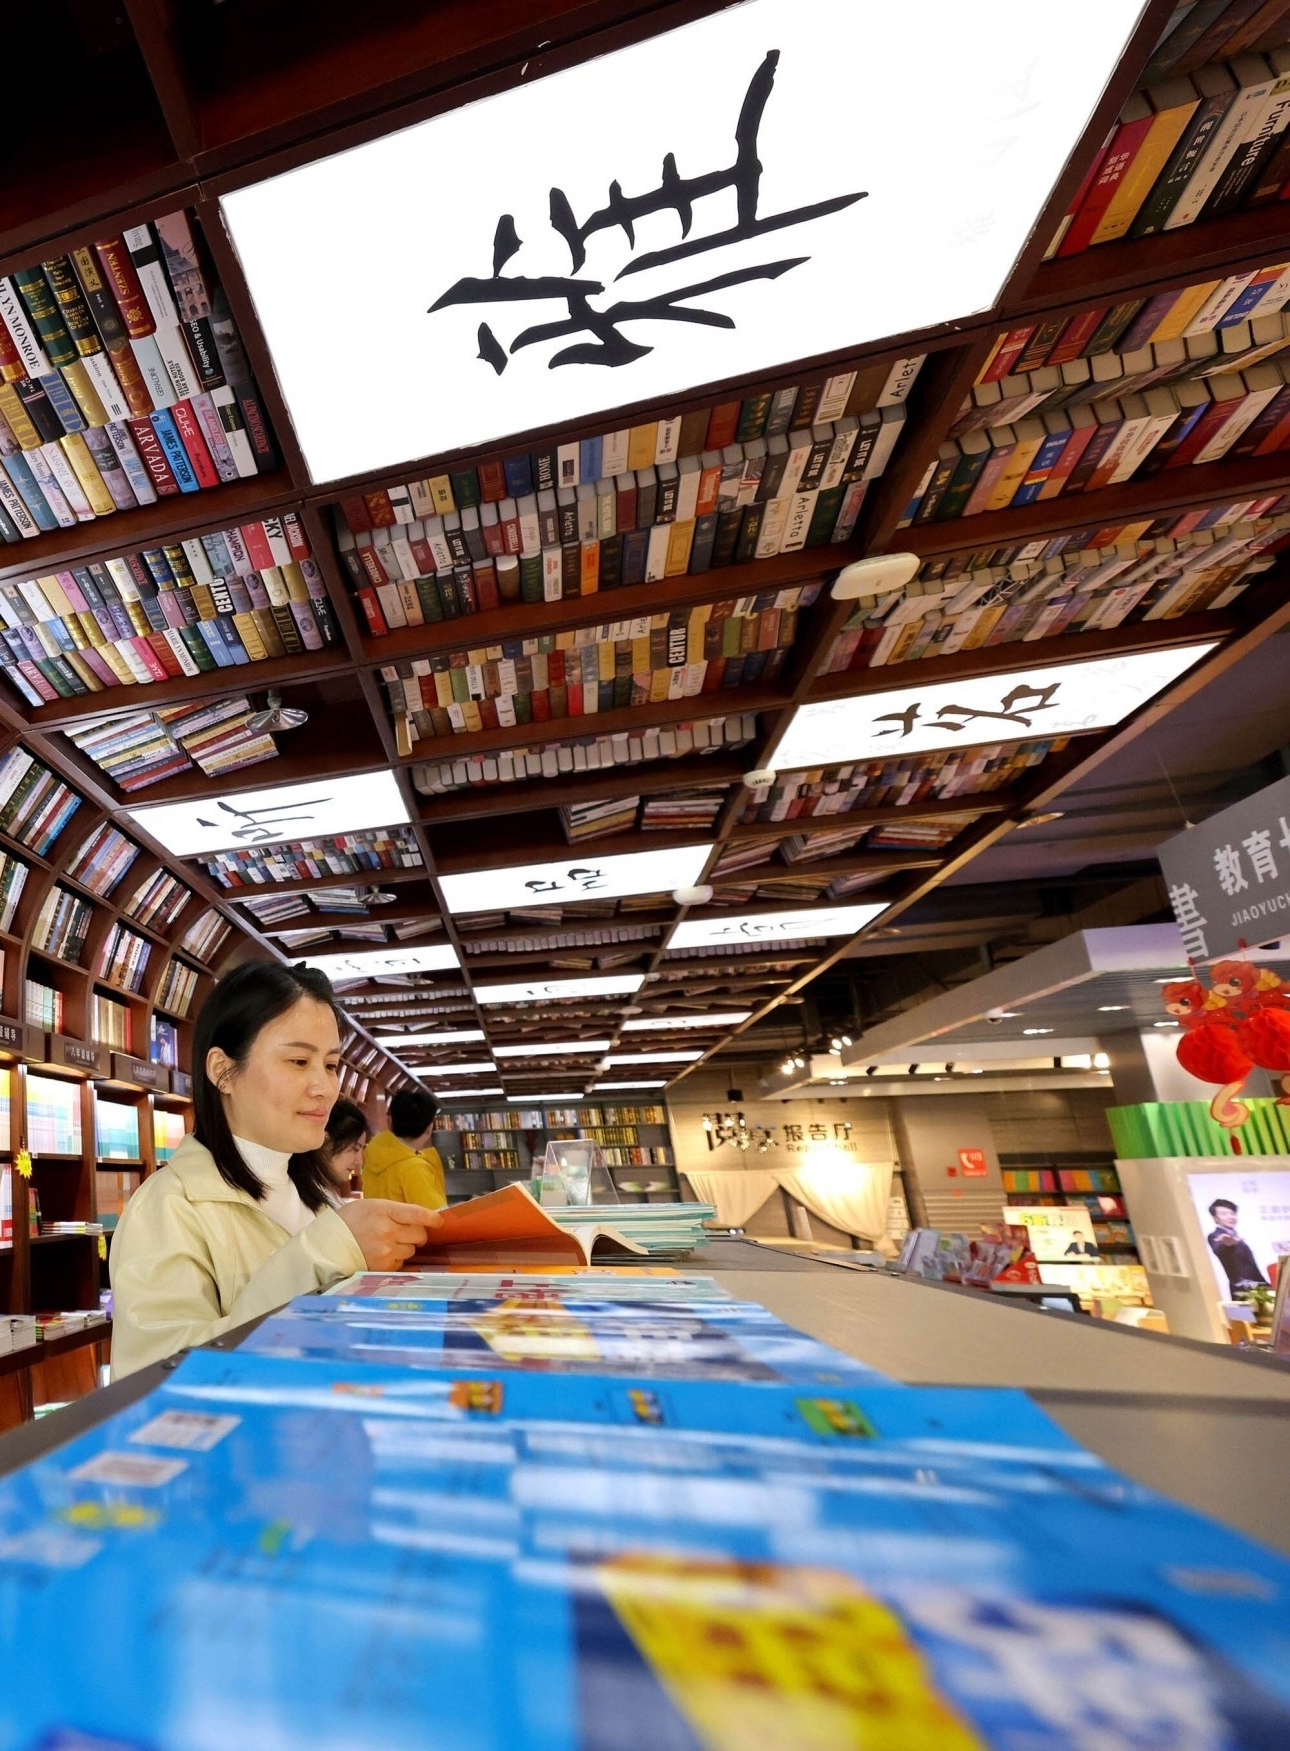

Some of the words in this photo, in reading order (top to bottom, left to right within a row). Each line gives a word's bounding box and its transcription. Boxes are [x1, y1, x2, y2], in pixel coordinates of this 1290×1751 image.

[427, 50, 869, 376] 雅
[105, 251, 130, 296] SZENTEN
[6, 313, 41, 372] MONROE
[194, 338, 212, 369] Usability
[146, 365, 165, 397] GERALDINE
[167, 360, 178, 378] HOTELS
[173, 377, 185, 397] DESIGN
[182, 381, 190, 394] YEAR
[107, 421, 126, 450] PATTERSON
[203, 408, 224, 445] BLAMELESS
[133, 421, 170, 484] ARVADA
[160, 427, 178, 451] JAMES
[169, 447, 192, 485] PATTERSON
[811, 451, 825, 464] LET
[858, 439, 871, 453] LET
[537, 455, 553, 480] HOME
[663, 489, 674, 498] LET
[7, 496, 32, 531] PATTERSON
[563, 511, 575, 535] Arletta
[787, 495, 811, 540] Arletta
[285, 521, 304, 548] JACKSON
[505, 522, 521, 552] CINDERELLA
[361, 550, 382, 585] CINDERELLA
[431, 541, 447, 565] Arletta
[21, 660, 53, 703] ARVADA
[871, 682, 1061, 739] 茗
[196, 797, 334, 842] 听
[783, 1123, 853, 1142] 报告厅
